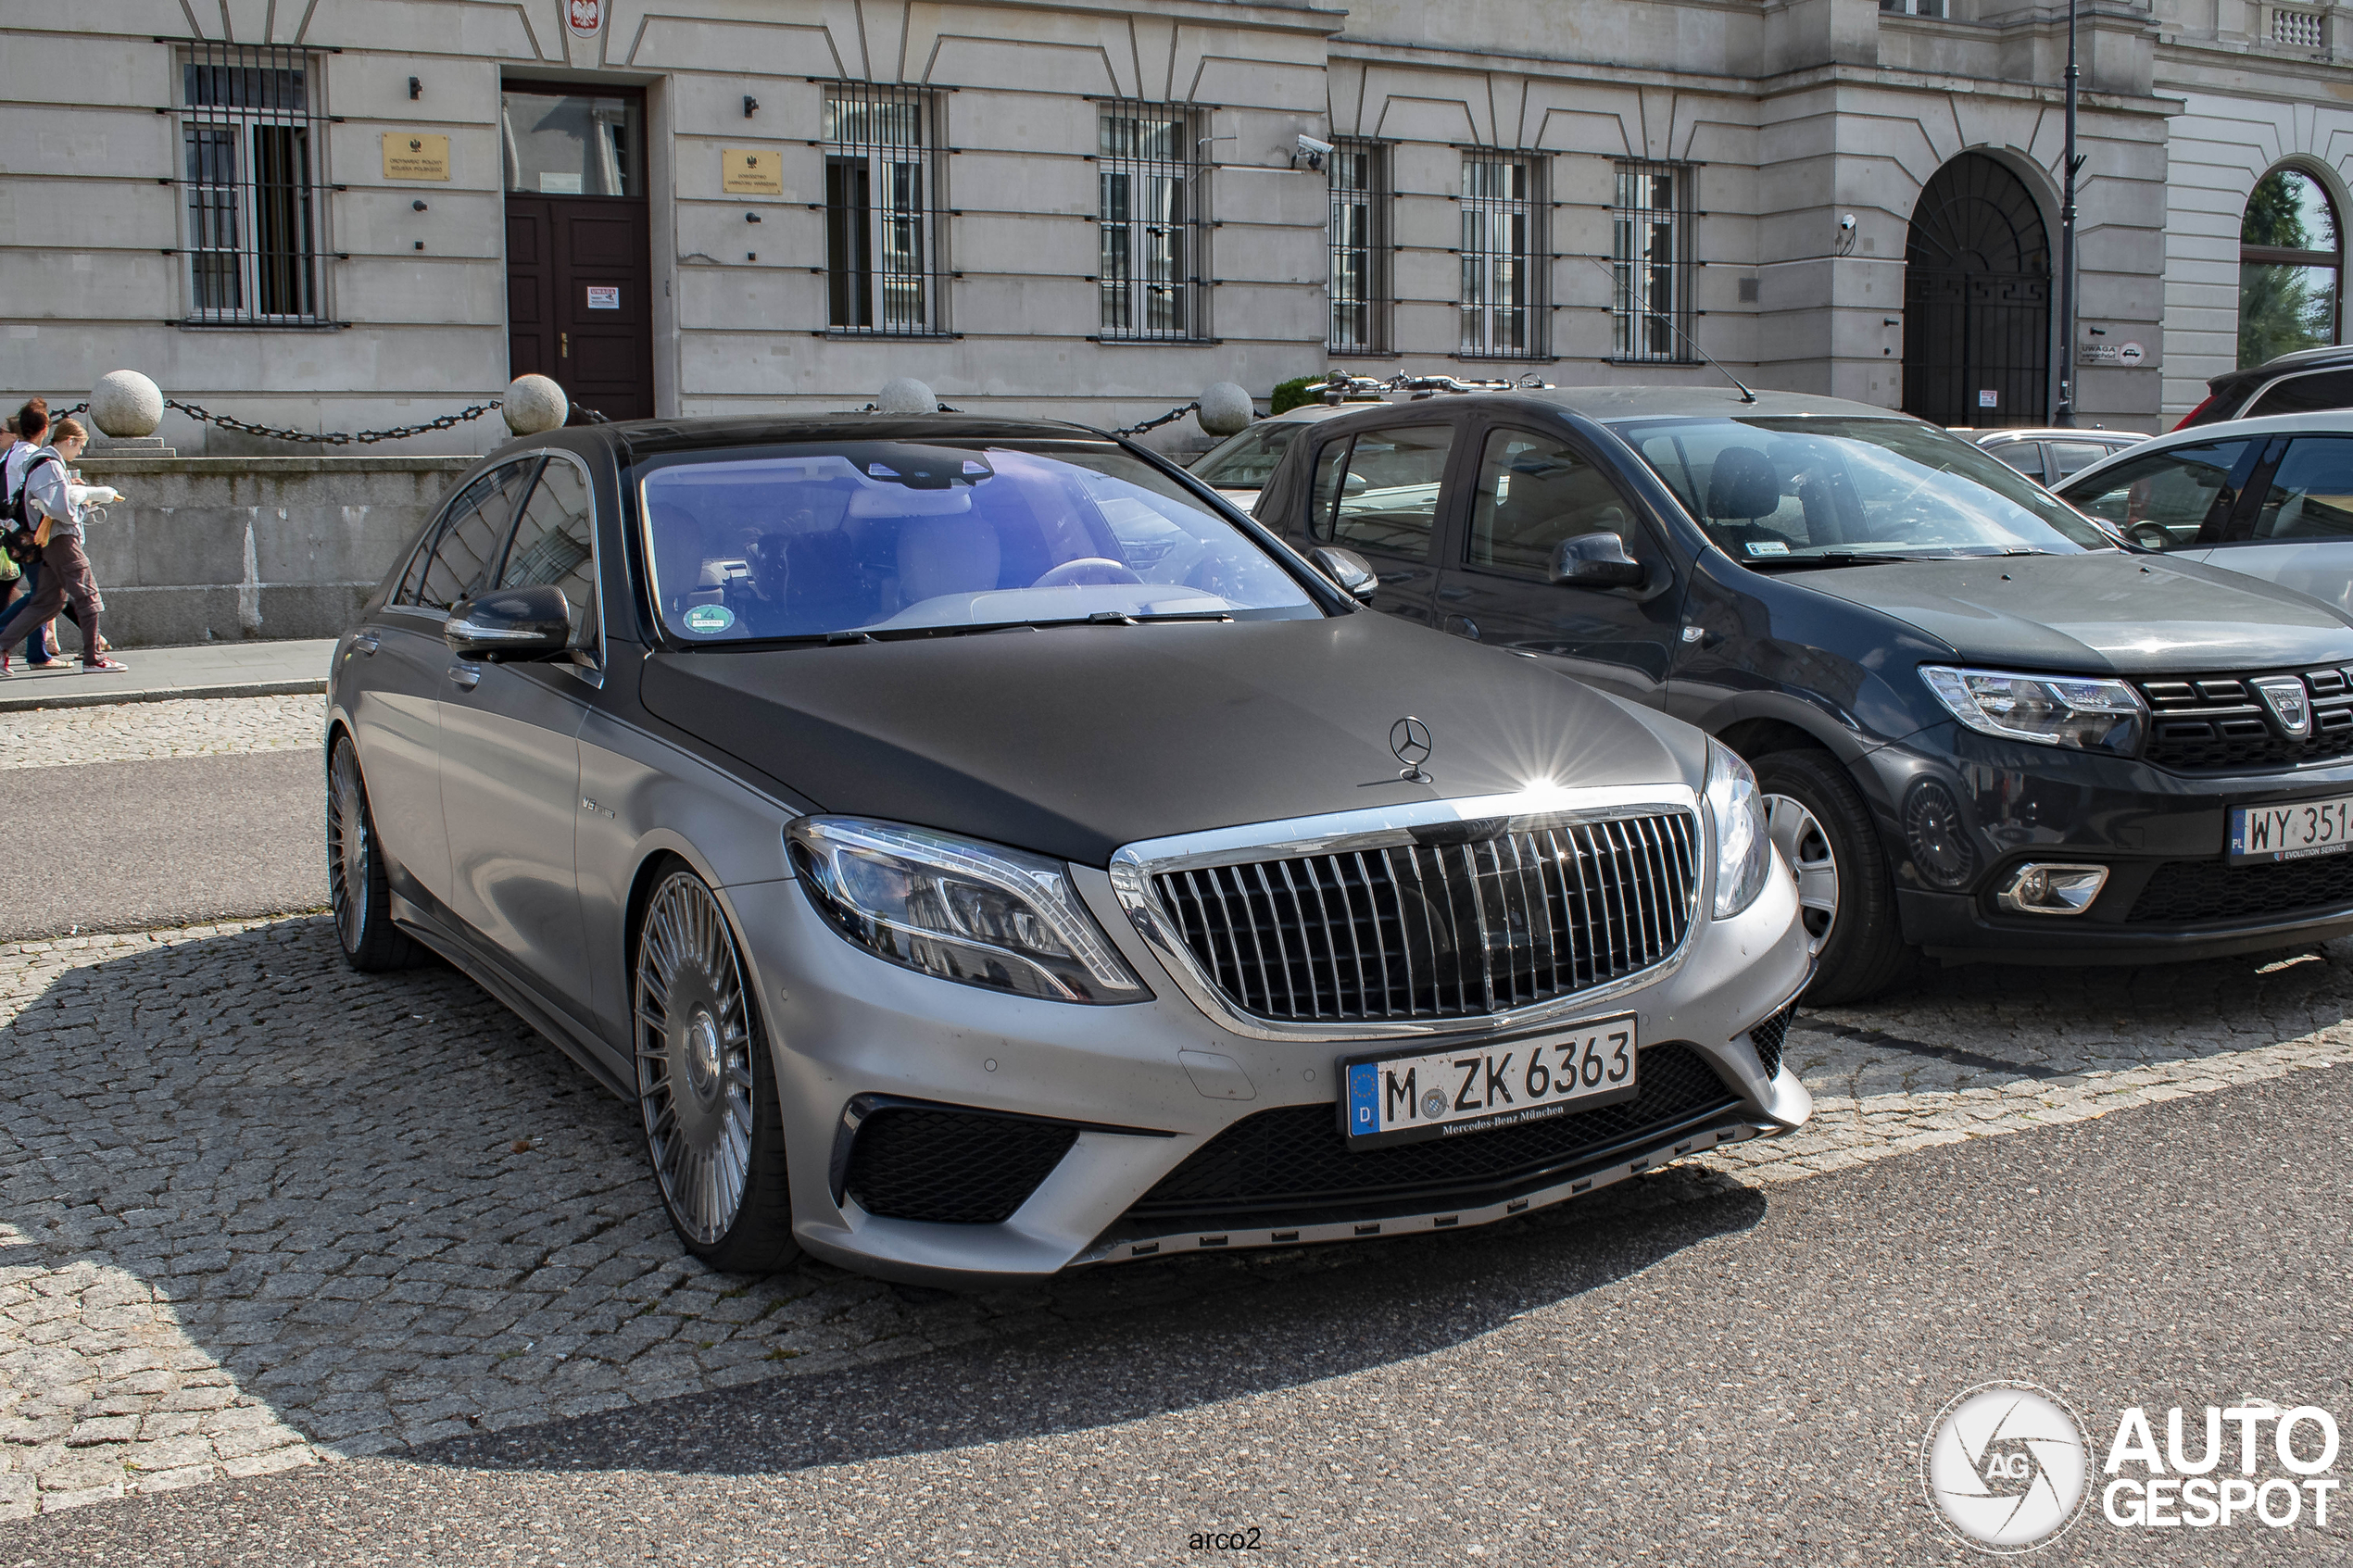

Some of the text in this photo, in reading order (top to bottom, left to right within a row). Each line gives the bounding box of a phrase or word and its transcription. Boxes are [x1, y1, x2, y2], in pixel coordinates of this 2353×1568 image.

[703, 608, 716, 620] 4
[2273, 691, 2301, 700] DACIA
[2251, 802, 2353, 851] WY 351
[2232, 838, 2244, 849] PL
[2284, 843, 2347, 859] EVOLUTION SERVICE
[1385, 1030, 1630, 1123] M ZK 6363
[1359, 1106, 1371, 1123] D
[1441, 1104, 1565, 1136] Mercedes-Benz München
